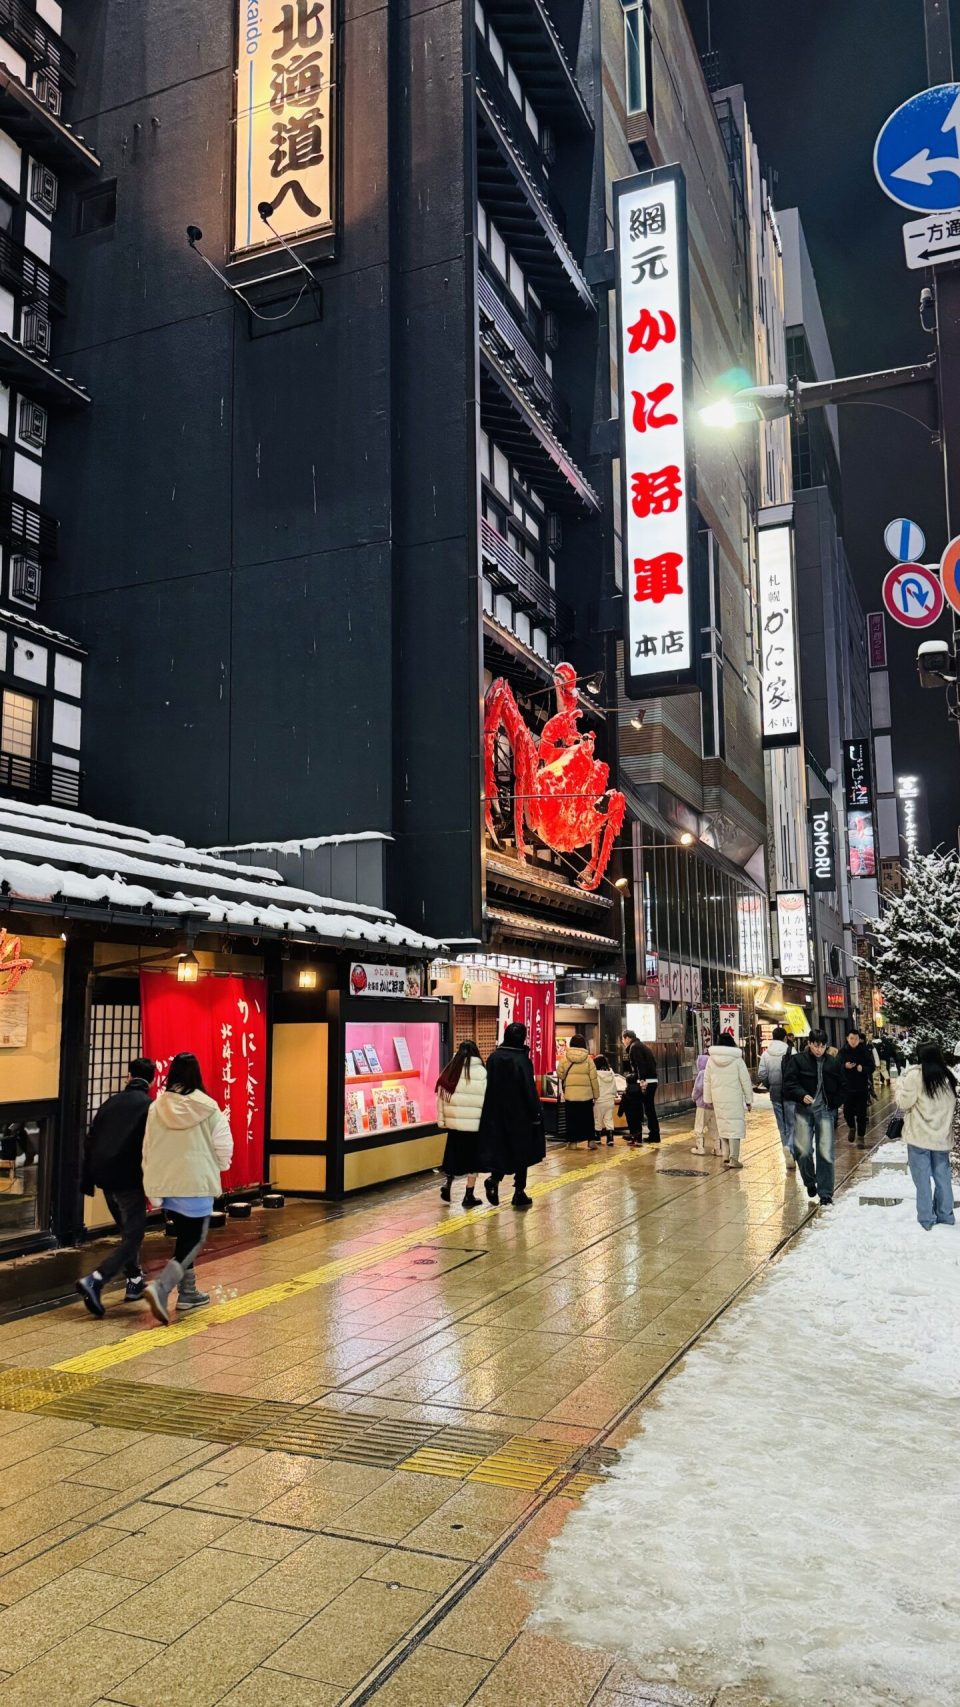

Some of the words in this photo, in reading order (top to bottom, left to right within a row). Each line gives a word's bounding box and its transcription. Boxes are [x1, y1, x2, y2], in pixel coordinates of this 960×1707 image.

[269, 0, 324, 218] 北海道へ
[635, 630, 684, 657] 本店
